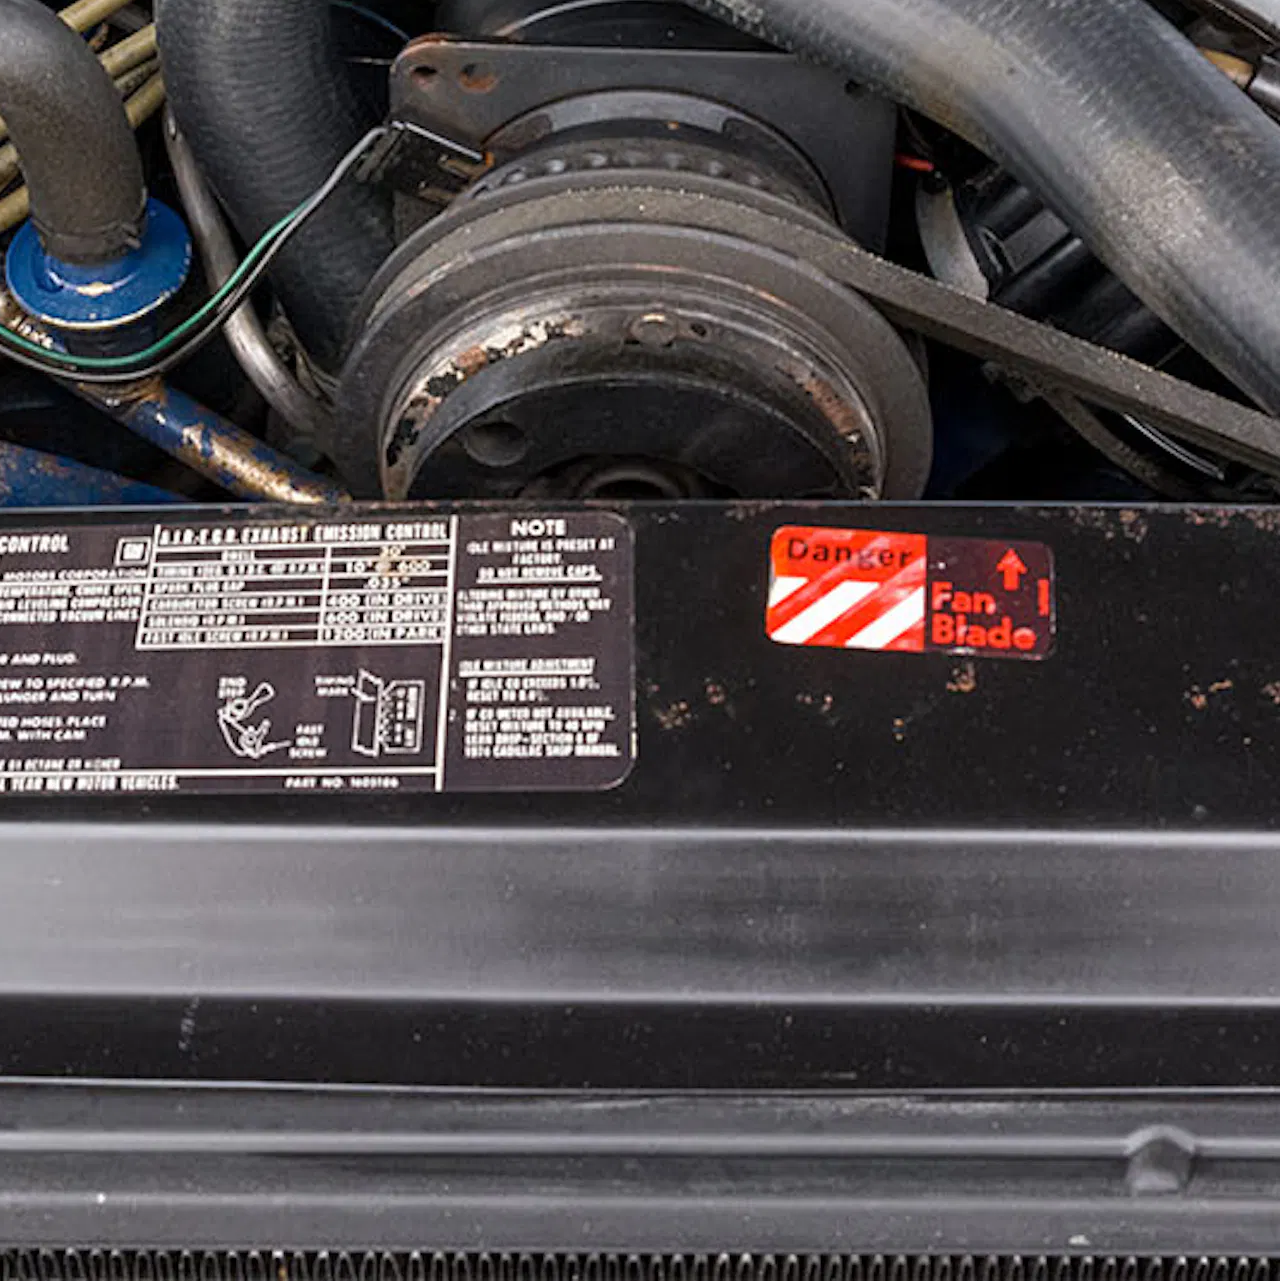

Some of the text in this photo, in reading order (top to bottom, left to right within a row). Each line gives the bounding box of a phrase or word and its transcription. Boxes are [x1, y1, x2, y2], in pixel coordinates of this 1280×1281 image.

[313, 523, 381, 542] EMISSION
[510, 518, 566, 537] NOTE
[787, 538, 914, 571] Danger
[931, 581, 997, 616] Fan
[931, 613, 1036, 651] Blade
